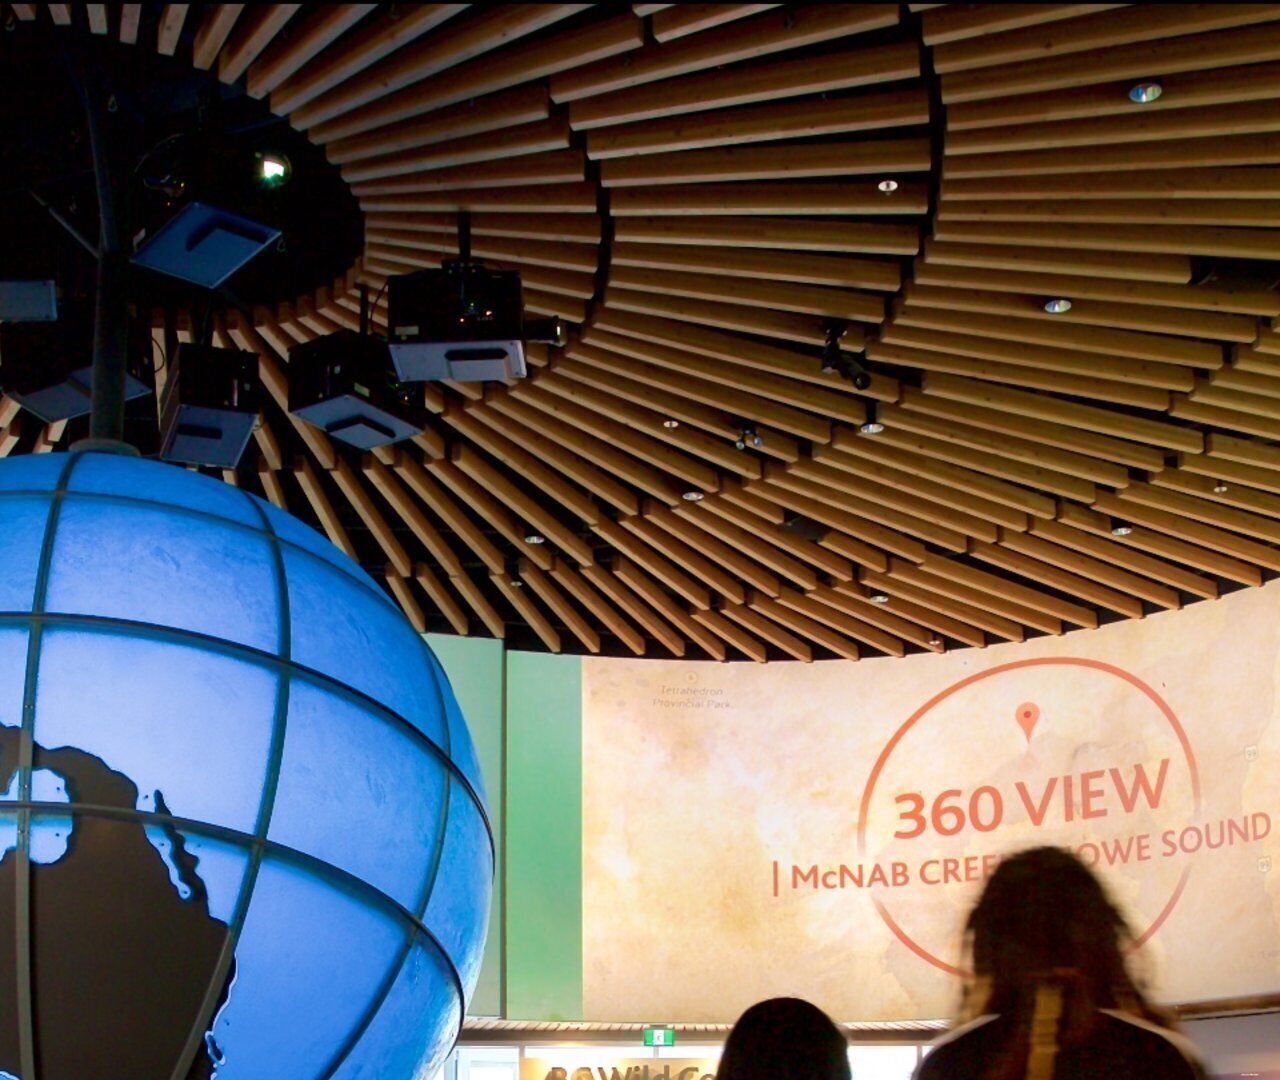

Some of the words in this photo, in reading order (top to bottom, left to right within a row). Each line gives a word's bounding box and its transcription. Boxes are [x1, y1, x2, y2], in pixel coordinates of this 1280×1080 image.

[893, 785, 1004, 840] 360
[1014, 758, 1170, 827] VIEW
[791, 862, 911, 890] McNAB
[919, 854, 997, 885] CREE
[1076, 833, 1151, 868] OWE
[1161, 811, 1272, 858] SOUND
